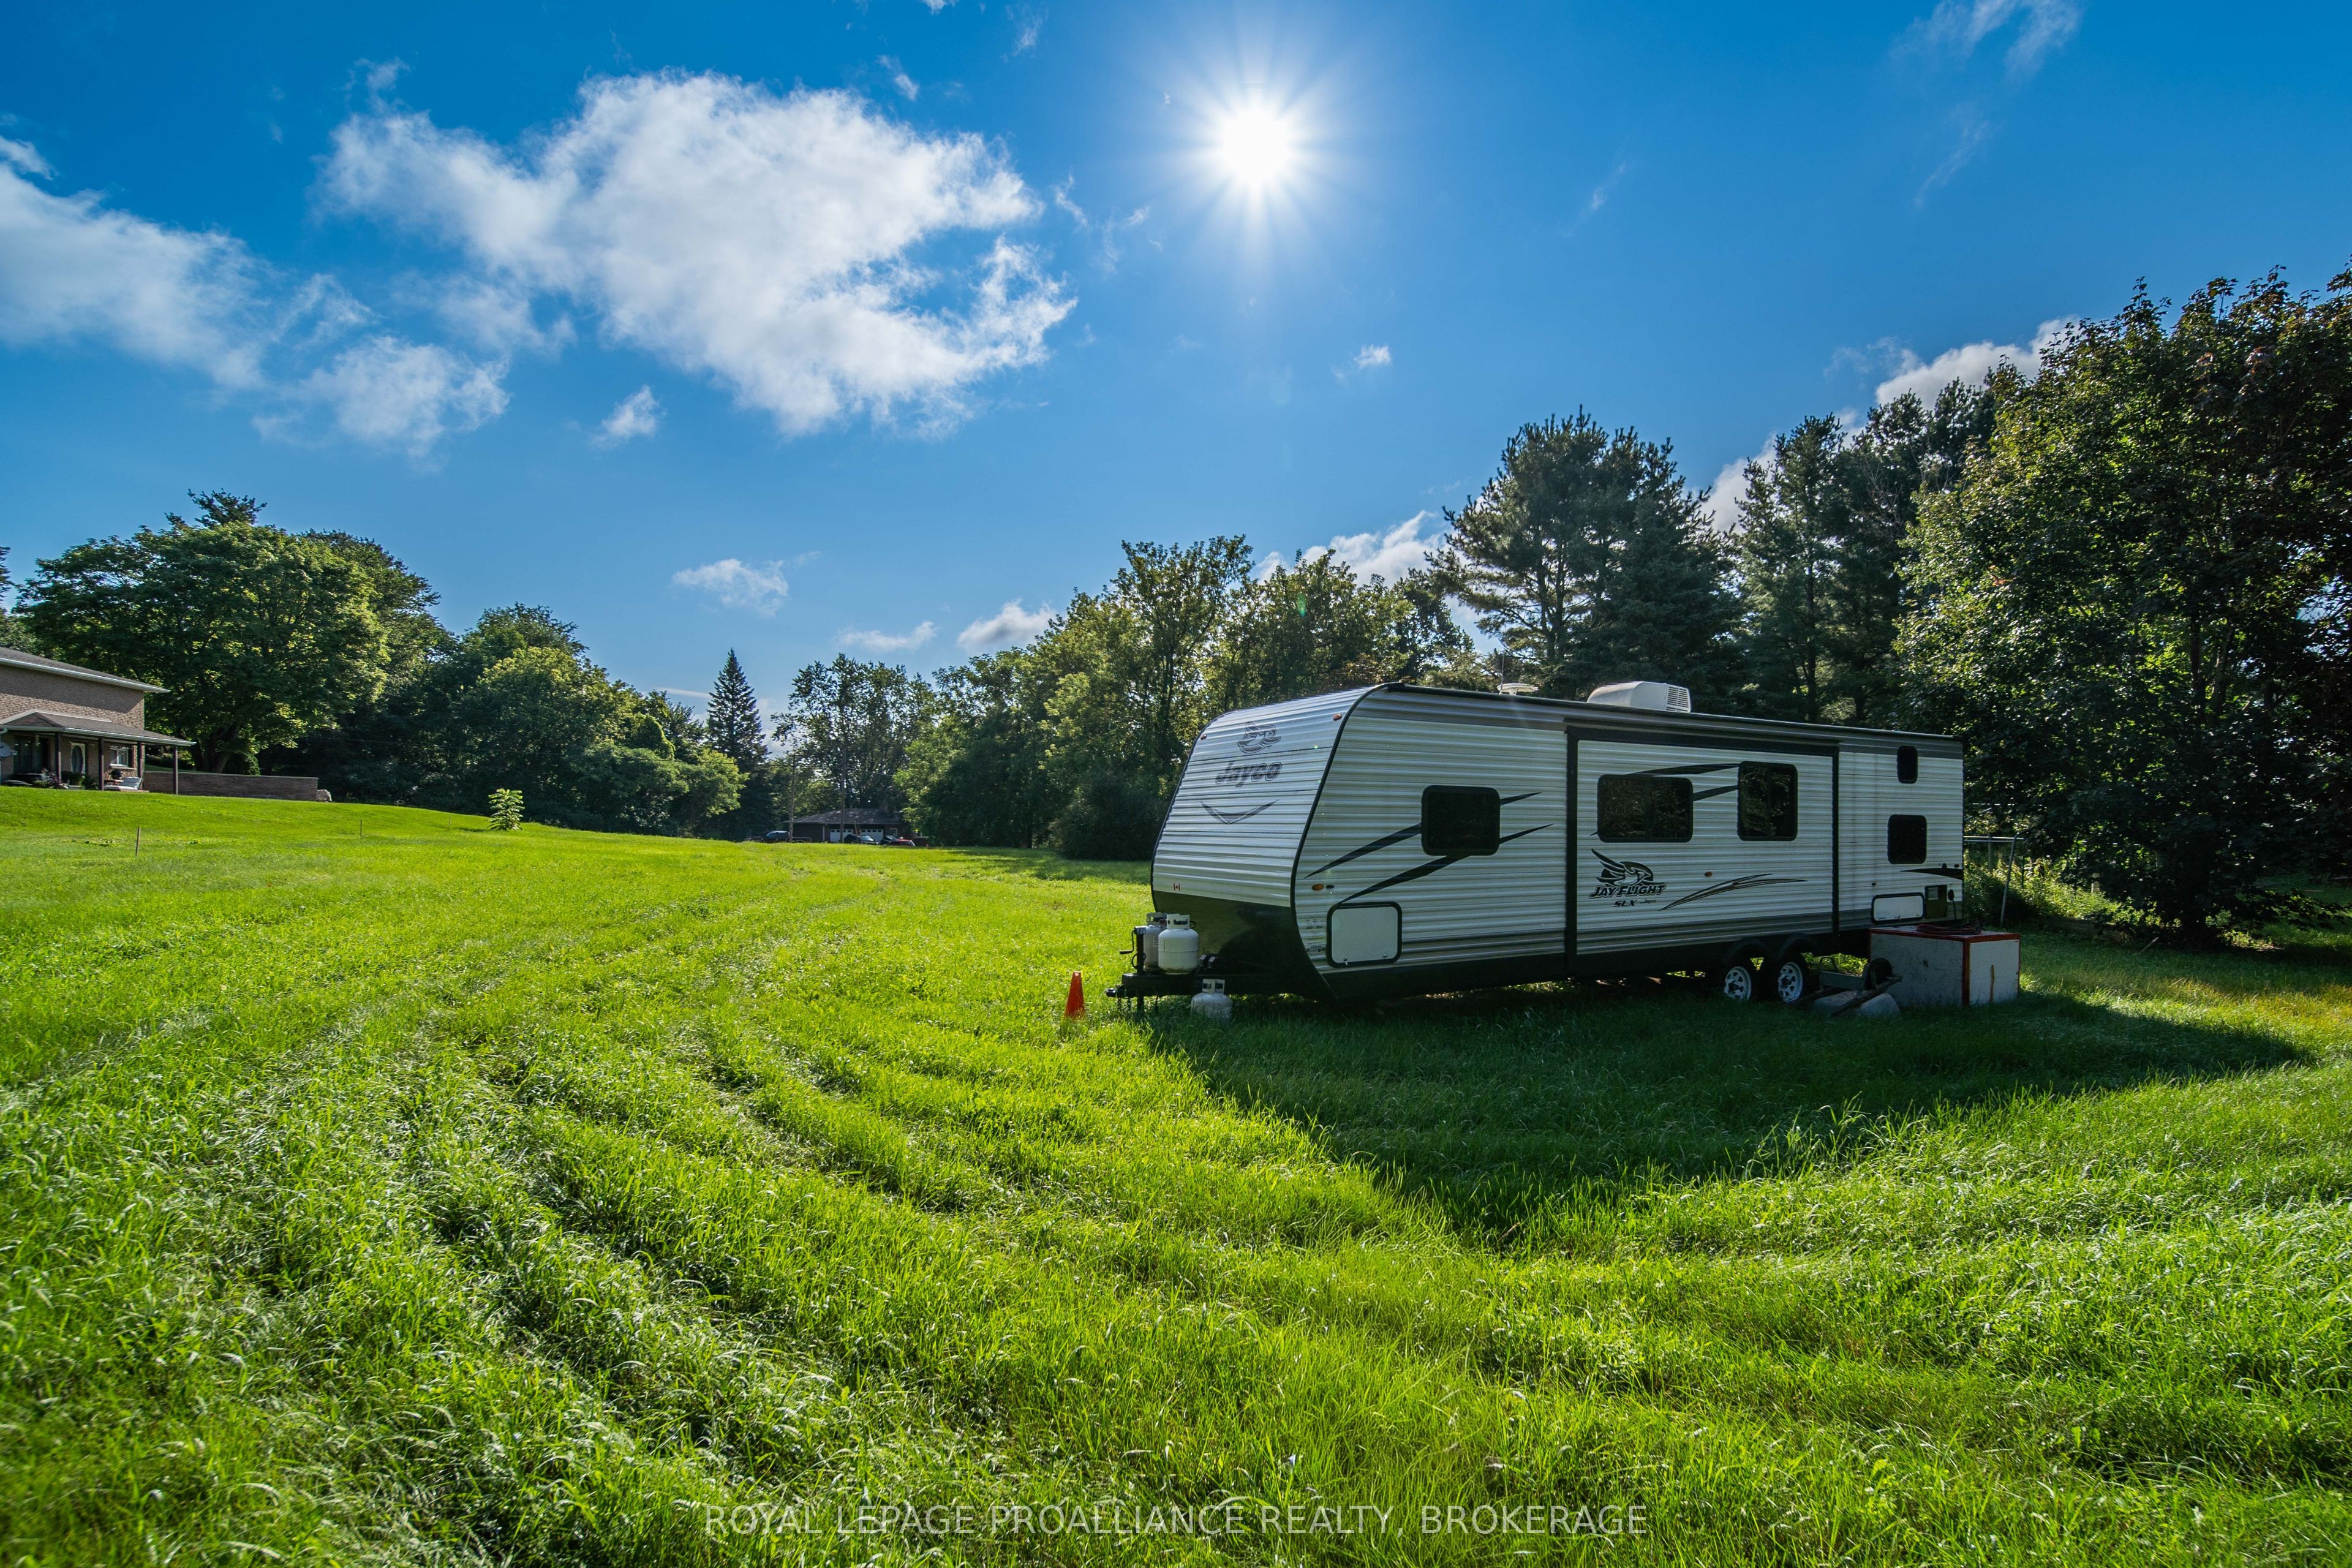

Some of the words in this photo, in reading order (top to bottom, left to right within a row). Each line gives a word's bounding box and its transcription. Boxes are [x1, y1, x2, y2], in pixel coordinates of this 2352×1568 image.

[1215, 760, 1283, 787] Jayco
[1589, 885, 1618, 899] JAY
[1616, 884, 1665, 897] FLIGHT
